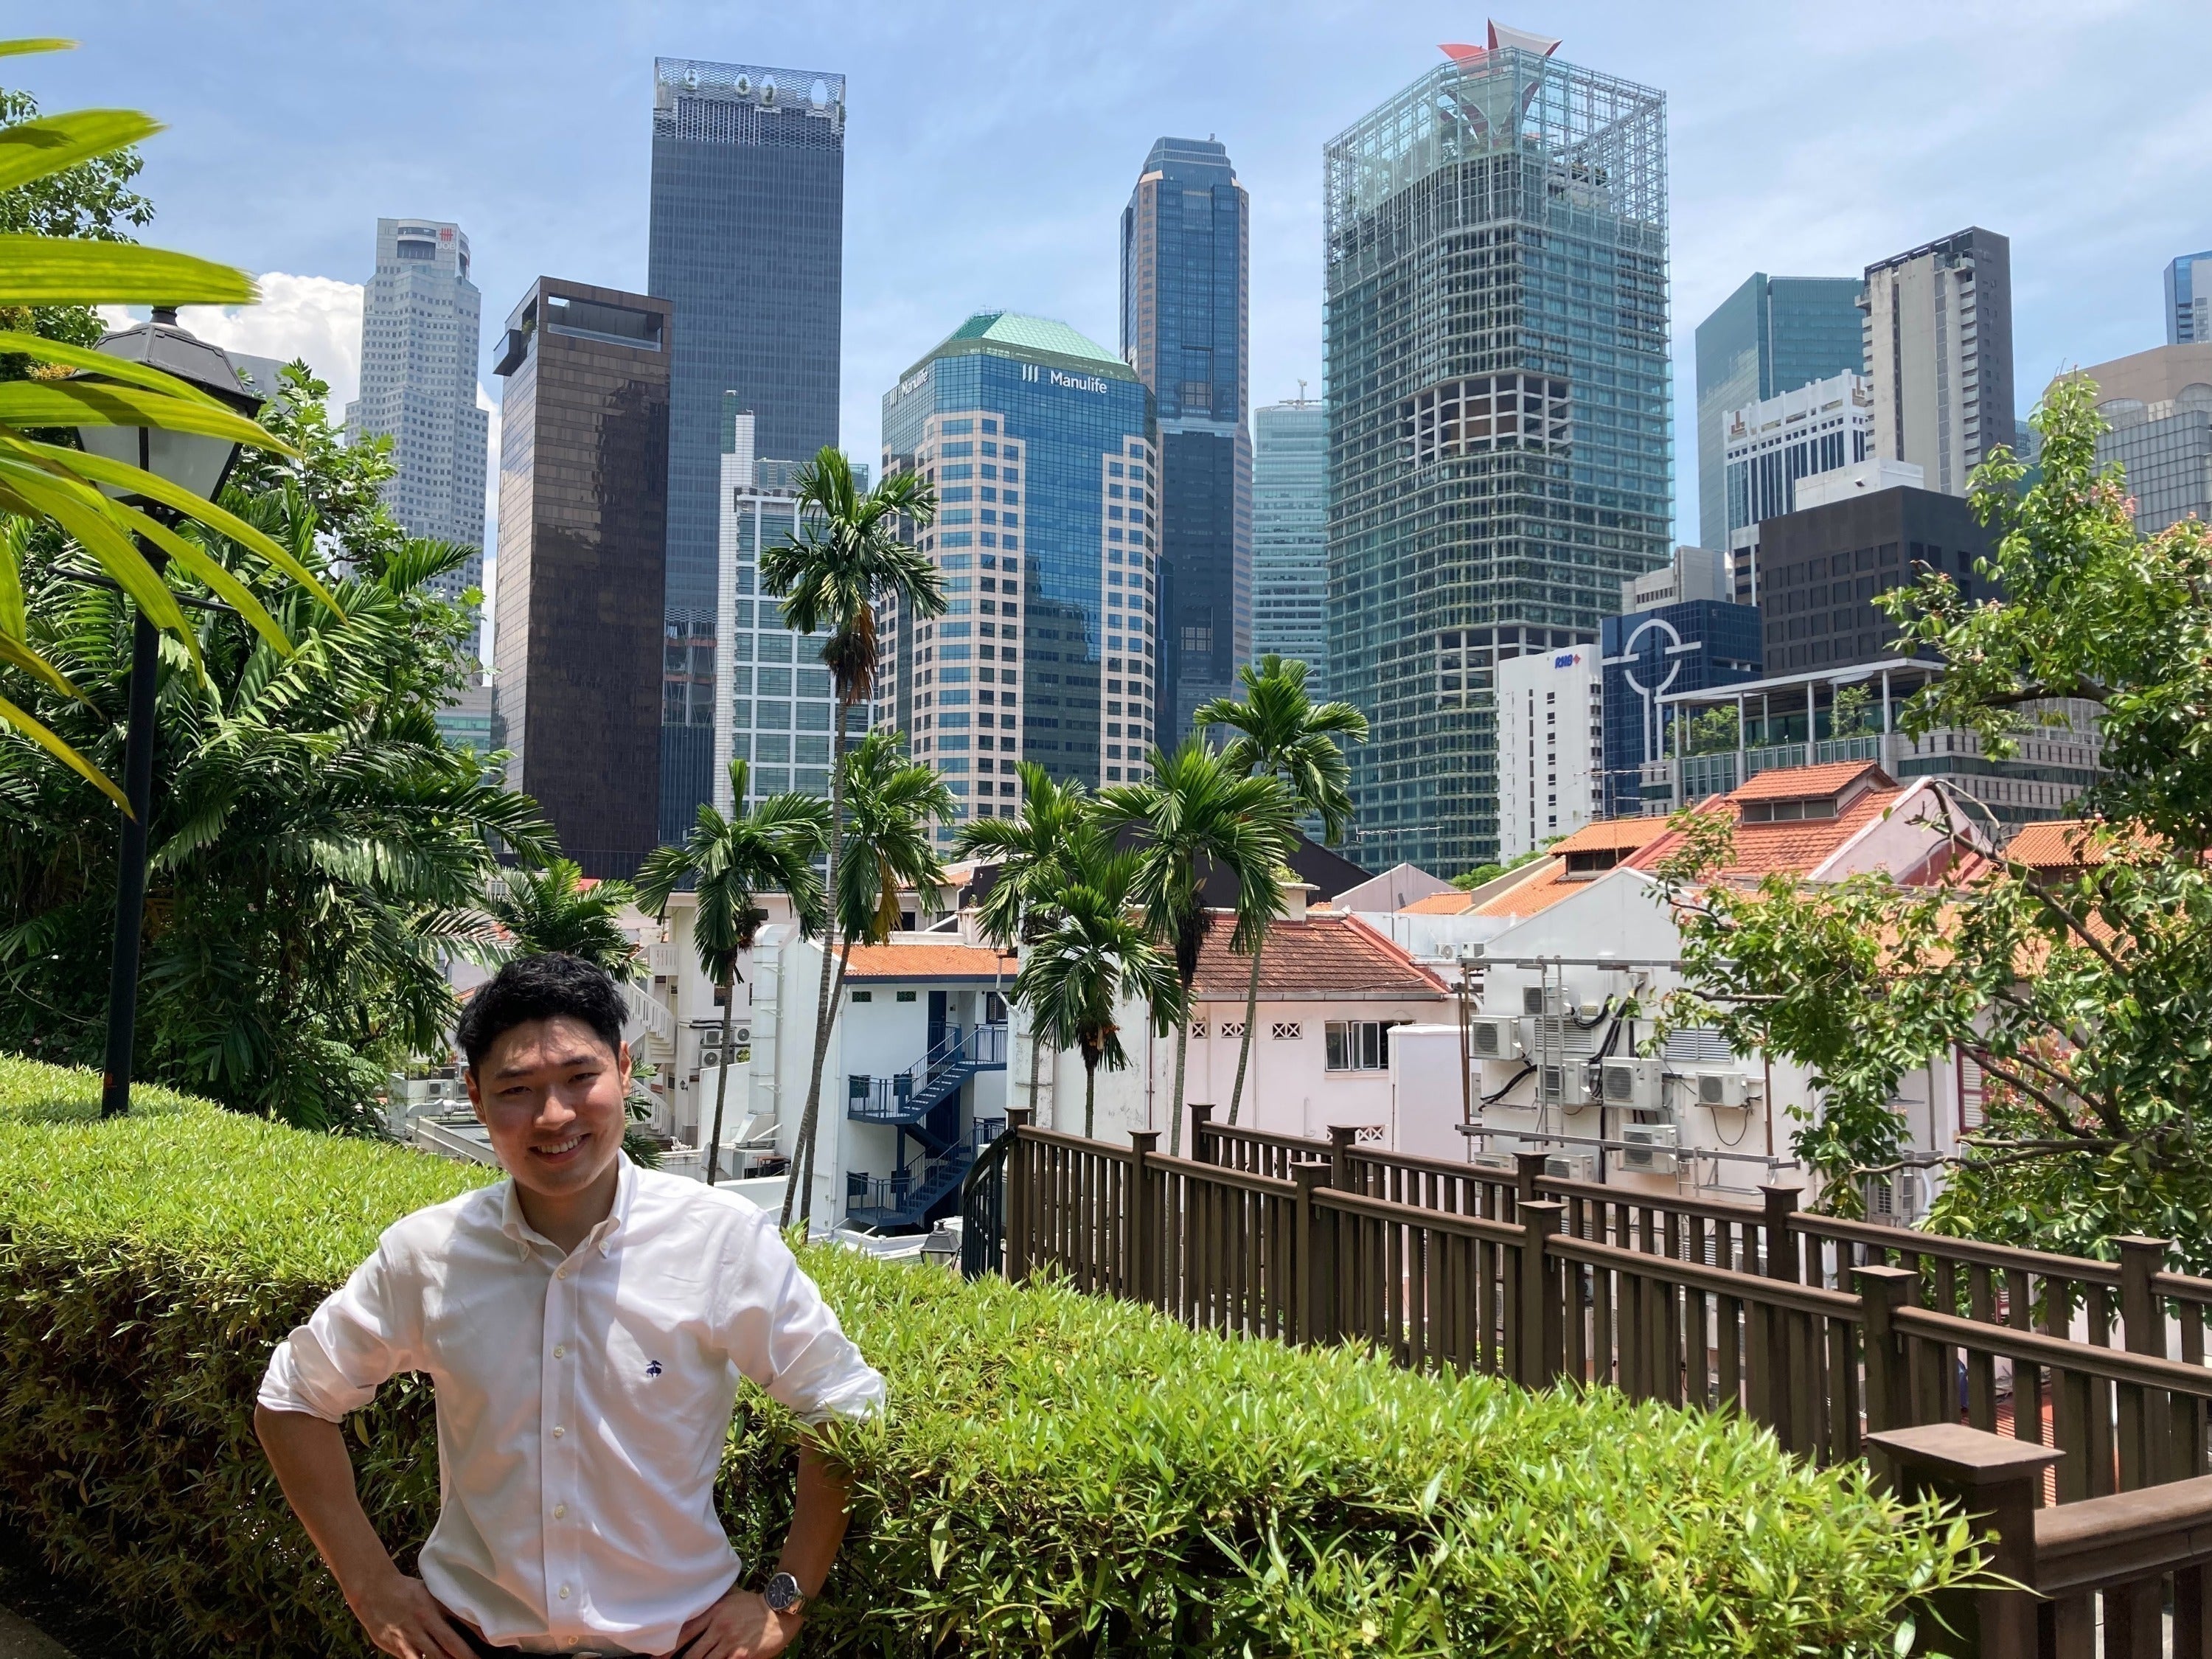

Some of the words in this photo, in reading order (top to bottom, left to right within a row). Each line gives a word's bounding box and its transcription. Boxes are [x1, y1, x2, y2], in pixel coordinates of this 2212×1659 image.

[436, 242, 456, 250] UOB
[902, 368, 929, 397] Manulife
[1050, 370, 1107, 394] Manulife
[1555, 654, 1573, 669] RHB
